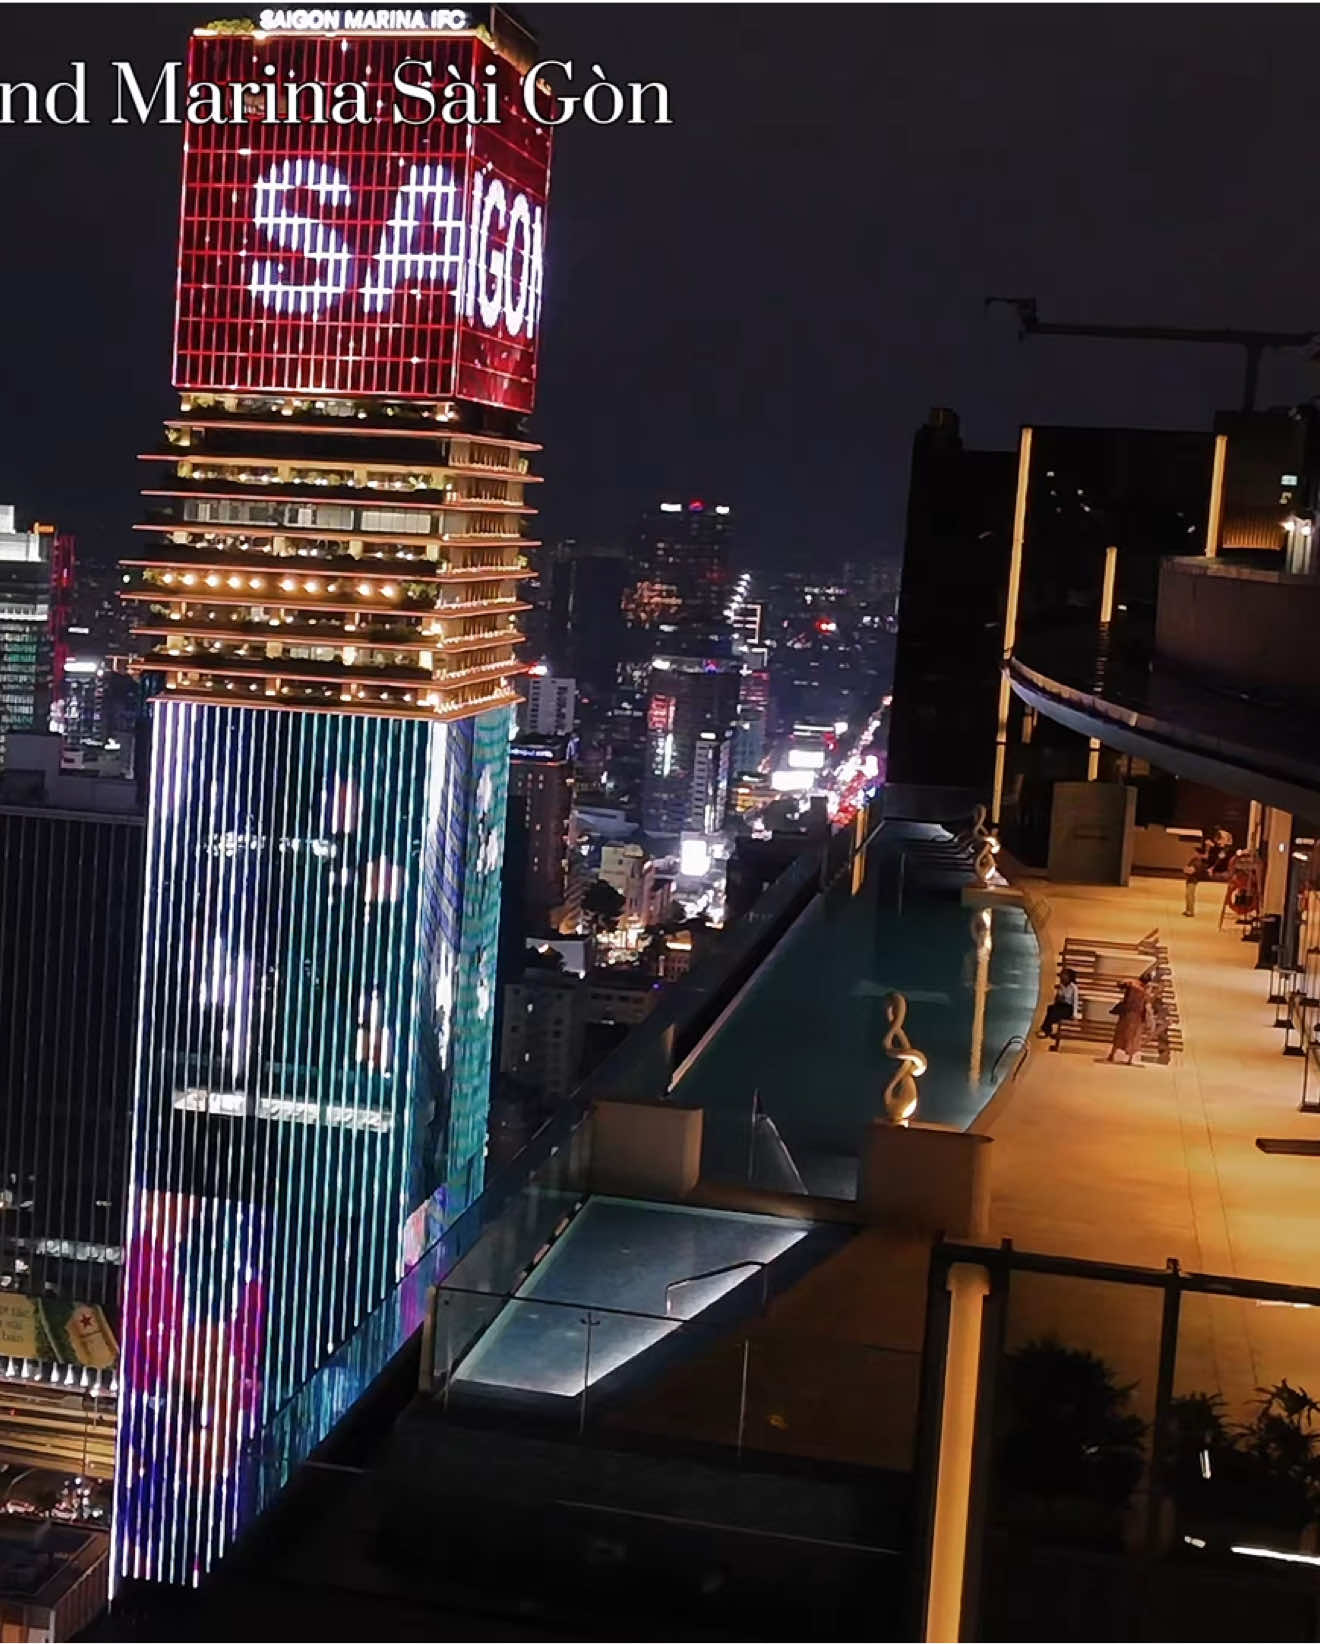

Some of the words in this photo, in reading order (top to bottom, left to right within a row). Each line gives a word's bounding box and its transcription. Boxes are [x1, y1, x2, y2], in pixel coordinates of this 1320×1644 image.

[260, 9, 340, 29] SAIGON
[344, 9, 426, 29] MARINA
[430, 9, 466, 29] IFC
